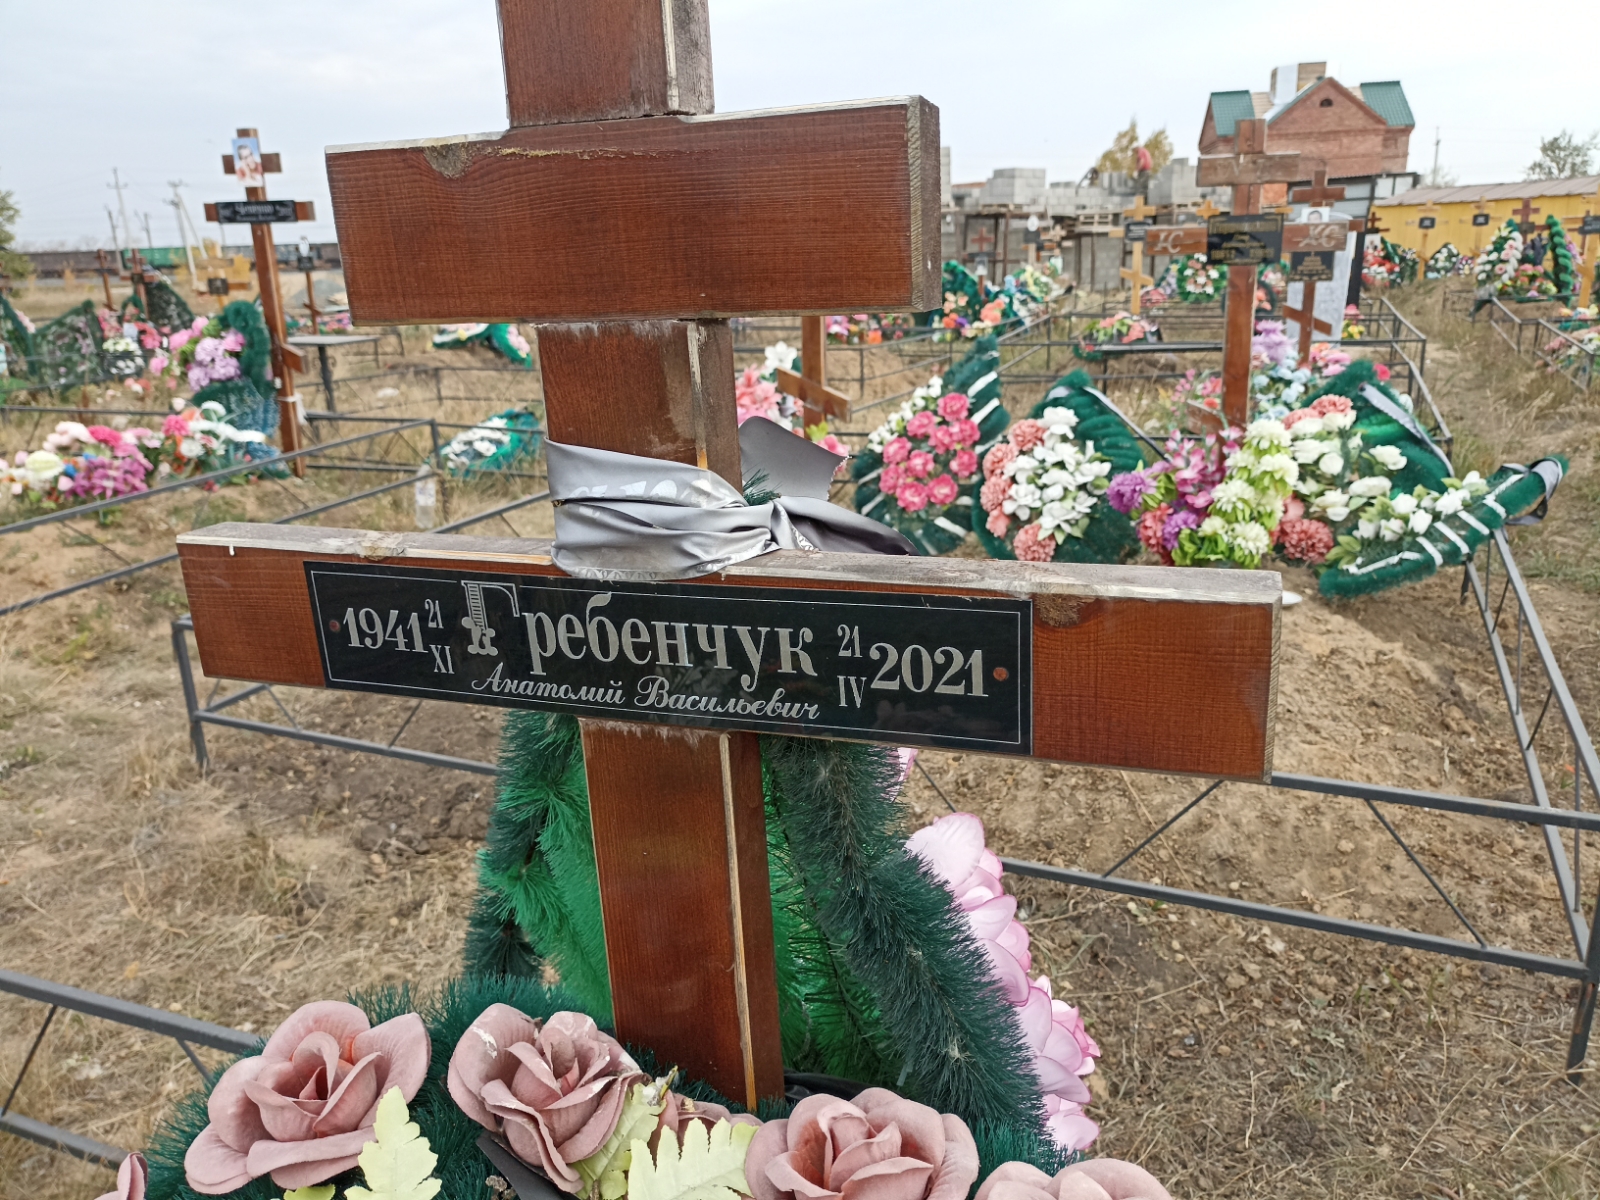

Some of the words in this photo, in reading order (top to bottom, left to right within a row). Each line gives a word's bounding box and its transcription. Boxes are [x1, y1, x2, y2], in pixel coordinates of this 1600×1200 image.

[343, 607, 428, 653] 1941
[424, 598, 444, 629] 21
[460, 580, 818, 692] Гребенчук
[837, 623, 864, 658] 21
[471, 662, 625, 705] Анатолий
[633, 675, 819, 720] Васильевич
[837, 675, 867, 709] IV
[869, 642, 989, 697] 2021
